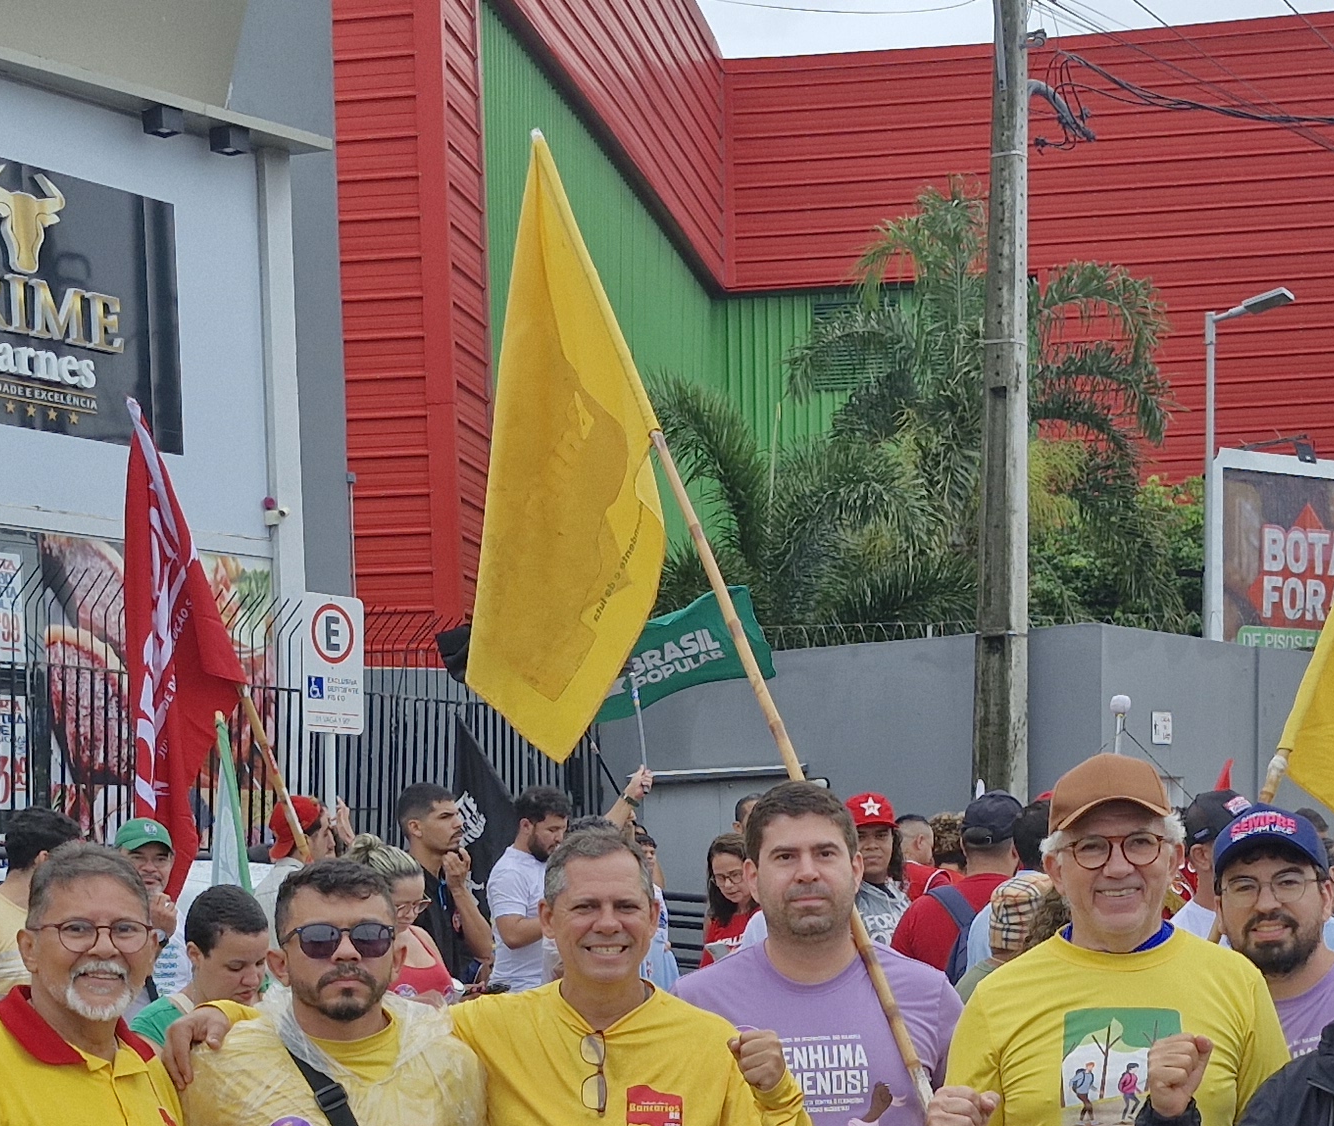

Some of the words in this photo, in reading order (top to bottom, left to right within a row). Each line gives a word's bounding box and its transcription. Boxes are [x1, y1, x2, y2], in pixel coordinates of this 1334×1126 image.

[25, 387, 33, 398] E
[34, 389, 98, 410] EXCELÊNCIA
[325, 615, 340, 652] E
[630, 628, 721, 676] BRASIL
[634, 649, 726, 688] POPULAR
[1230, 813, 1298, 839] SEMPRE
[782, 1043, 869, 1070] ENHUMA
